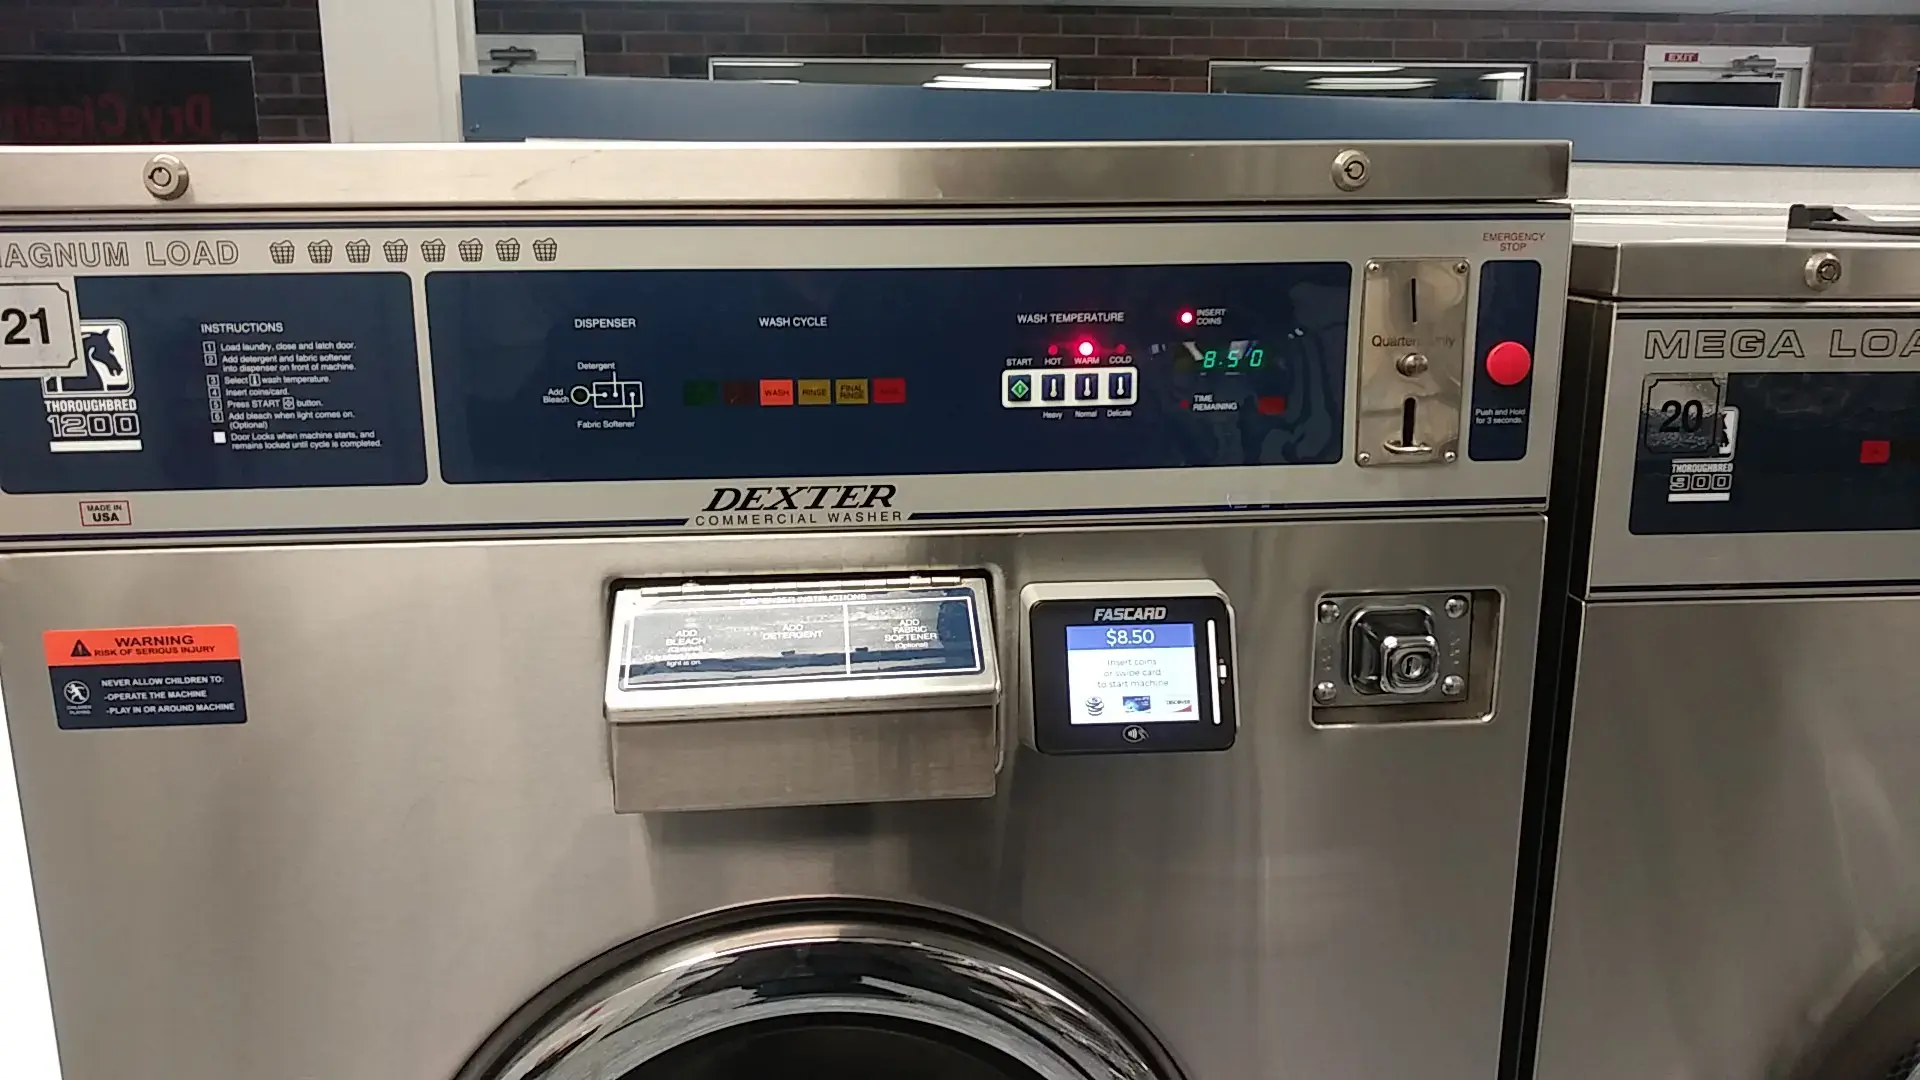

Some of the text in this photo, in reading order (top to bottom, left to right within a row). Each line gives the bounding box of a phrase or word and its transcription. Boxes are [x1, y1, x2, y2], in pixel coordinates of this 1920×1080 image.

[1667, 53, 1695, 62] EXIT
[1483, 232, 1545, 242] EMERGENCY
[1500, 242, 1527, 252] STOP
[0, 241, 239, 268] AGNUM LOAD
[1196, 308, 1226, 317] INSERT
[758, 316, 828, 328] WASH CYCLE
[1016, 312, 1124, 324] WASH TEMPERATURE
[1196, 317, 1222, 326] COINS
[1, 307, 50, 345] 21
[200, 323, 284, 334] INSTRUCTIONS
[574, 318, 637, 329] DISPENSER
[220, 343, 240, 352] Load
[242, 342, 274, 353] laundry,
[276, 342, 296, 351] close
[298, 342, 314, 350] and
[316, 341, 334, 350] latch
[336, 341, 356, 350] door.
[1645, 329, 1805, 360] MEGA
[222, 356, 238, 364] Add
[240, 354, 278, 364] detergent
[279, 354, 294, 362] and
[296, 354, 318, 362] fabric
[319, 354, 352, 362] softener
[1006, 355, 1132, 366] START HOT WARM COLD
[222, 364, 238, 372] into
[240, 364, 278, 374] dispenser
[280, 364, 290, 372] on
[320, 362, 356, 370] machine.
[577, 361, 616, 372] Detergent
[224, 376, 248, 385] Select
[262, 376, 282, 384] wash
[283, 376, 331, 384] temperature.
[226, 388, 247, 396] Insert
[547, 388, 564, 397] Add
[764, 389, 790, 397] WASH
[802, 388, 827, 397] RINSE
[840, 384, 864, 392] FINAL
[542, 396, 570, 404] Bleach
[1194, 394, 1213, 402] TIME
[44, 399, 137, 414] THOROUGHBRED
[227, 400, 250, 408] Press
[252, 400, 280, 408] START
[296, 399, 323, 407] button.
[1192, 402, 1238, 412] REMAINING
[228, 412, 244, 420] Add
[246, 412, 272, 420] bleach
[274, 412, 295, 420] when
[296, 411, 313, 421] light
[1042, 408, 1132, 420] Heavy Normal Delicate
[1475, 408, 1526, 416] Push and Hold
[1660, 399, 1704, 434] 20
[46, 412, 140, 438] 1200
[577, 420, 636, 430] Fabric Softener
[1476, 416, 1486, 424] for
[229, 421, 268, 430] (Optional)
[231, 433, 250, 441] Door
[252, 432, 276, 440] Locks
[276, 432, 298, 440] when
[299, 432, 332, 440] machine
[232, 440, 382, 450] remains locked until cycle is completed.
[1671, 463, 1734, 474] THOROUGHBRED
[701, 484, 897, 512] DEXTER
[86, 504, 122, 512] MADE IN
[92, 512, 120, 522] USA
[695, 510, 902, 527] COMMERCIAL WASHER
[1093, 606, 1167, 622] FASCARD
[782, 624, 804, 632] ADD
[892, 626, 928, 634] FABRIC
[675, 629, 698, 638] ADD
[762, 630, 824, 640] DETERGENT
[884, 632, 938, 642] SOFTENER
[1106, 628, 1156, 648] $8.50
[114, 635, 195, 648] WARNING
[666, 637, 706, 646] BLEACH
[94, 646, 216, 657] RISK OF SERIOUS INJURY
[1107, 658, 1157, 666] Insert coins
[1142, 668, 1162, 676] card
[101, 676, 224, 688] NEVER ALLOW CHILDREN TO:
[1097, 679, 1169, 689] to start machine
[149, 691, 166, 700] THE
[168, 690, 208, 698] MACHINE
[132, 706, 142, 714] IN
[143, 705, 156, 714] OR
[157, 704, 194, 713] AROUND
[195, 702, 236, 712] MACHINE
